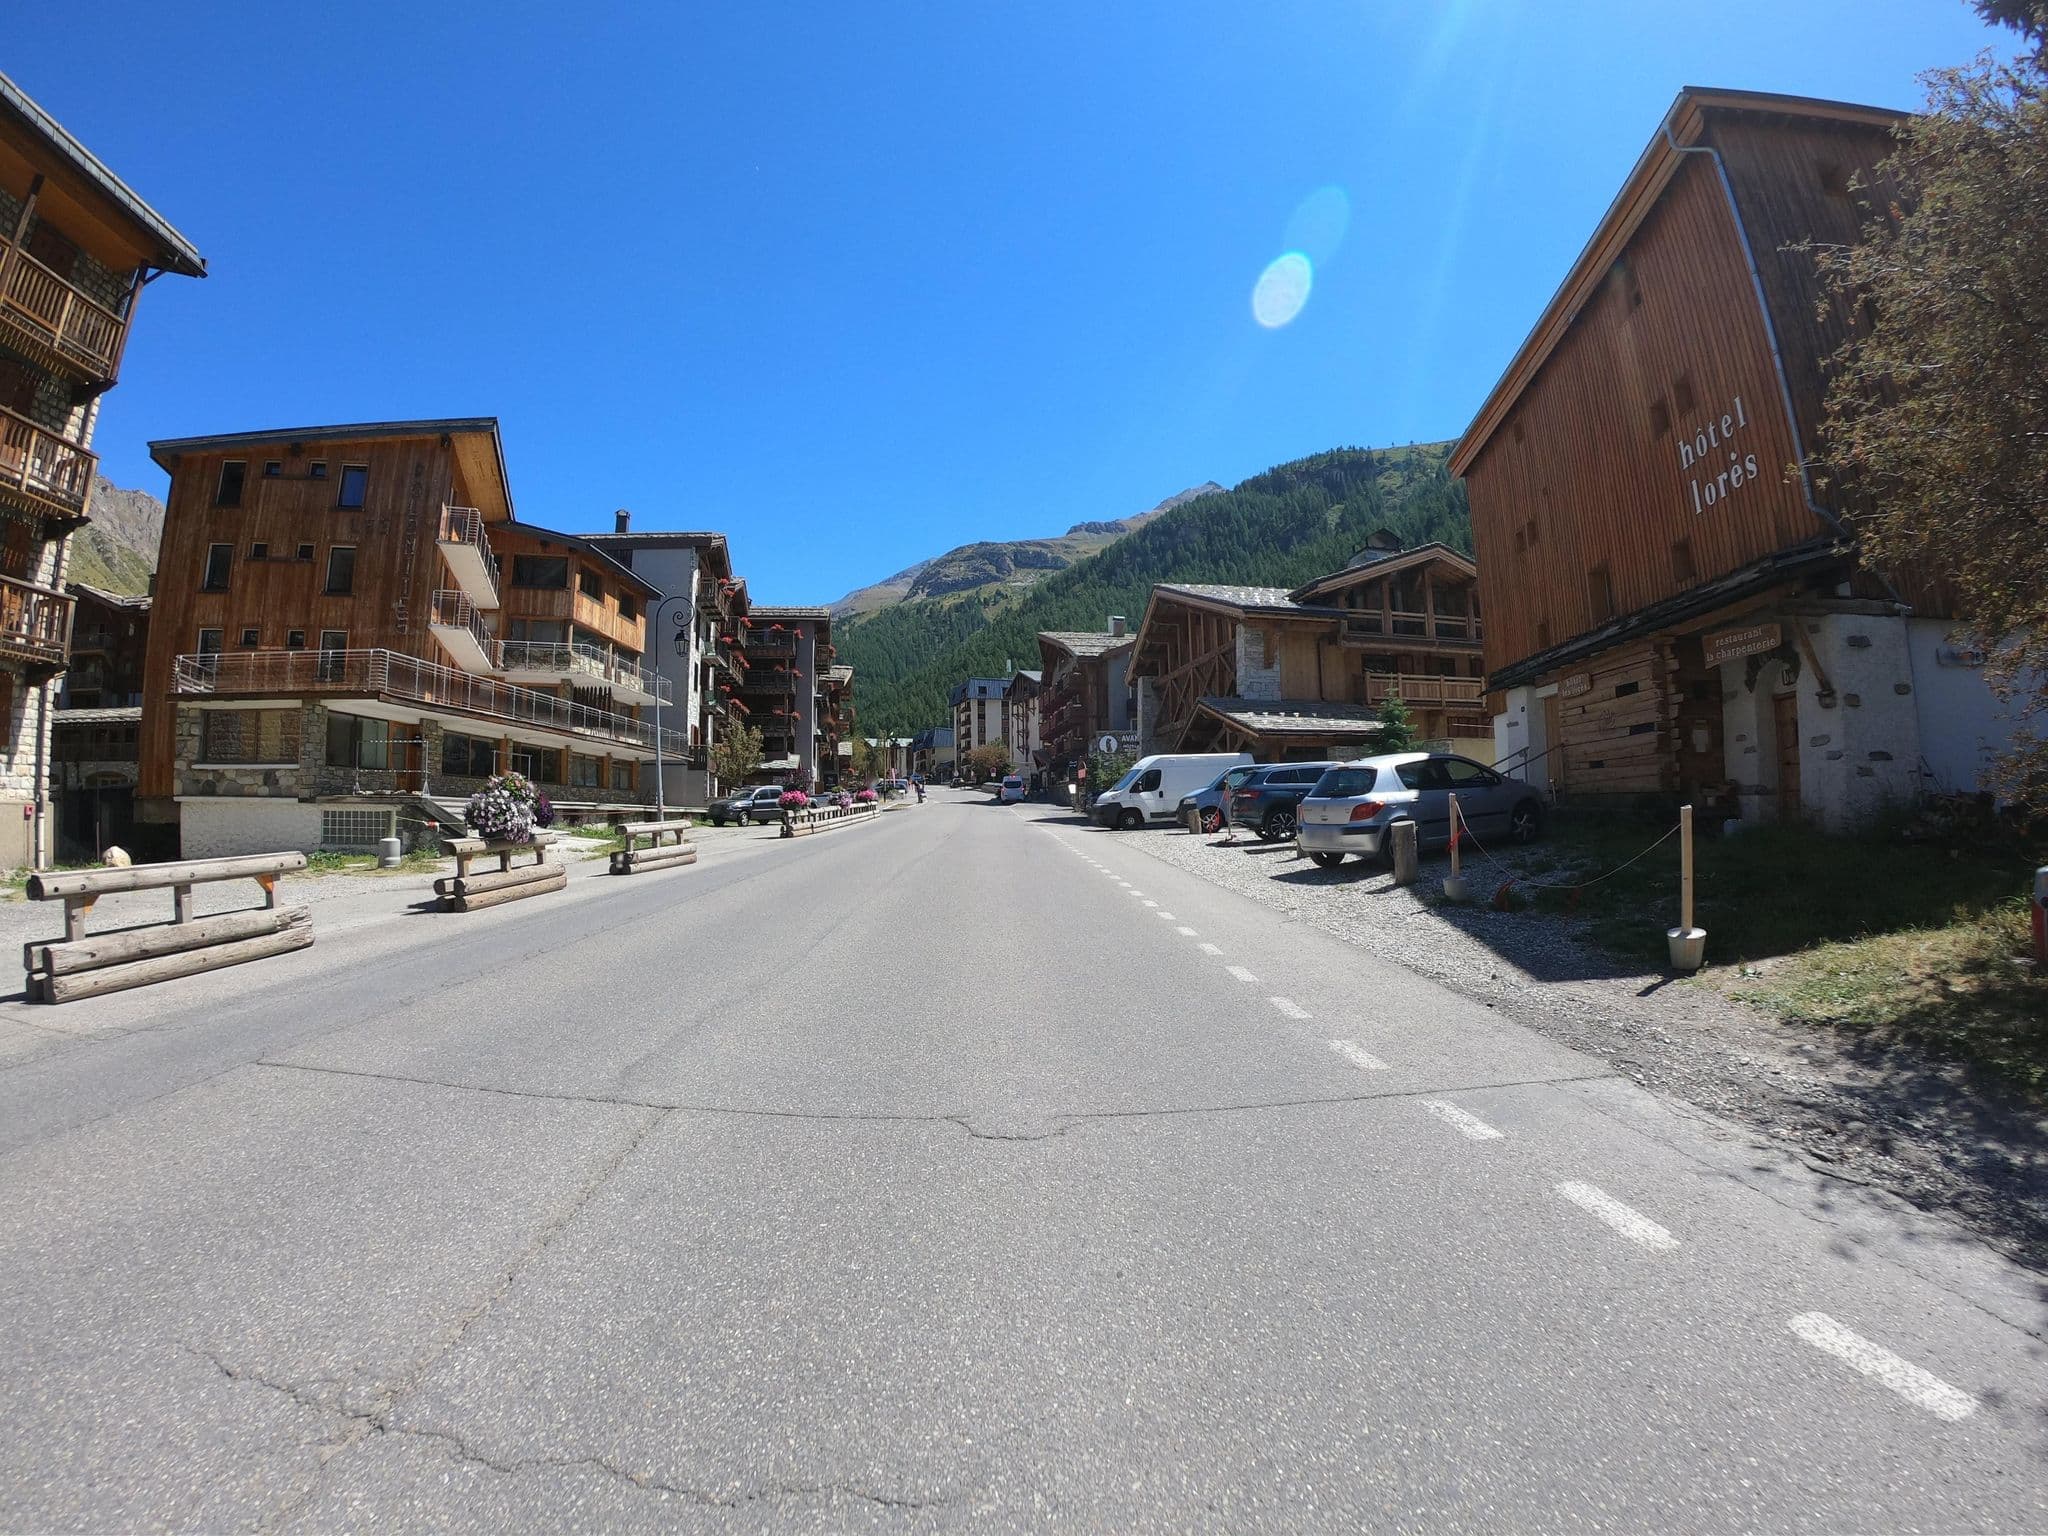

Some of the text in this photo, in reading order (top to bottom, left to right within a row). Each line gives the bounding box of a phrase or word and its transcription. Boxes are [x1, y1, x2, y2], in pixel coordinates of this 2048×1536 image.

[1678, 396, 1747, 470] hôtel
[1715, 627, 1763, 647] restaurant
[1716, 638, 1777, 657] charpenterie
